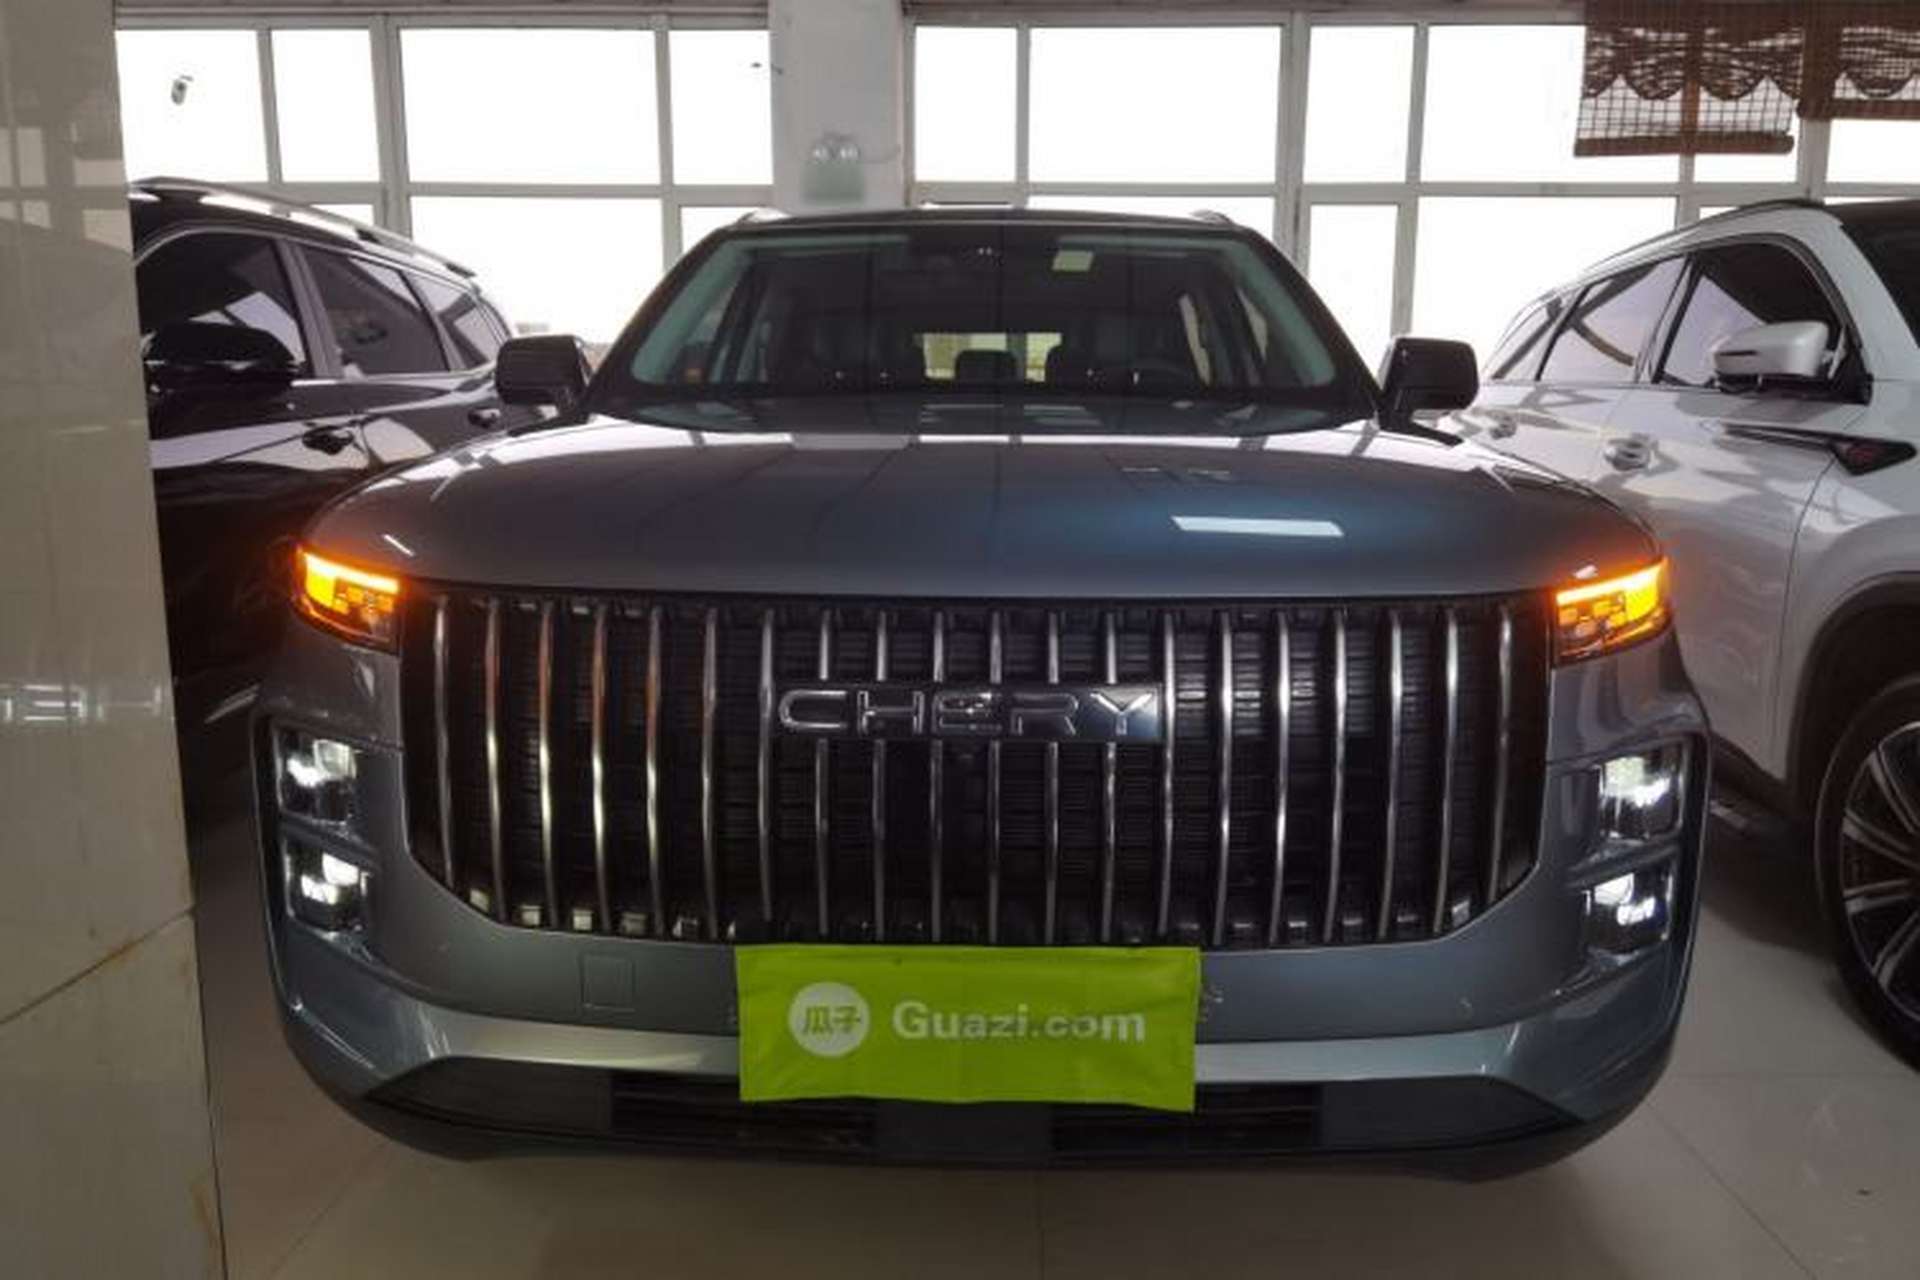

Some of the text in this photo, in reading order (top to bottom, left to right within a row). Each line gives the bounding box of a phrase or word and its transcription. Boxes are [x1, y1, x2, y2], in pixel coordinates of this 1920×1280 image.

[778, 688, 1153, 736] CHERY
[803, 1005, 862, 1036] 瓜子
[894, 1001, 1146, 1042] Guazi.com
